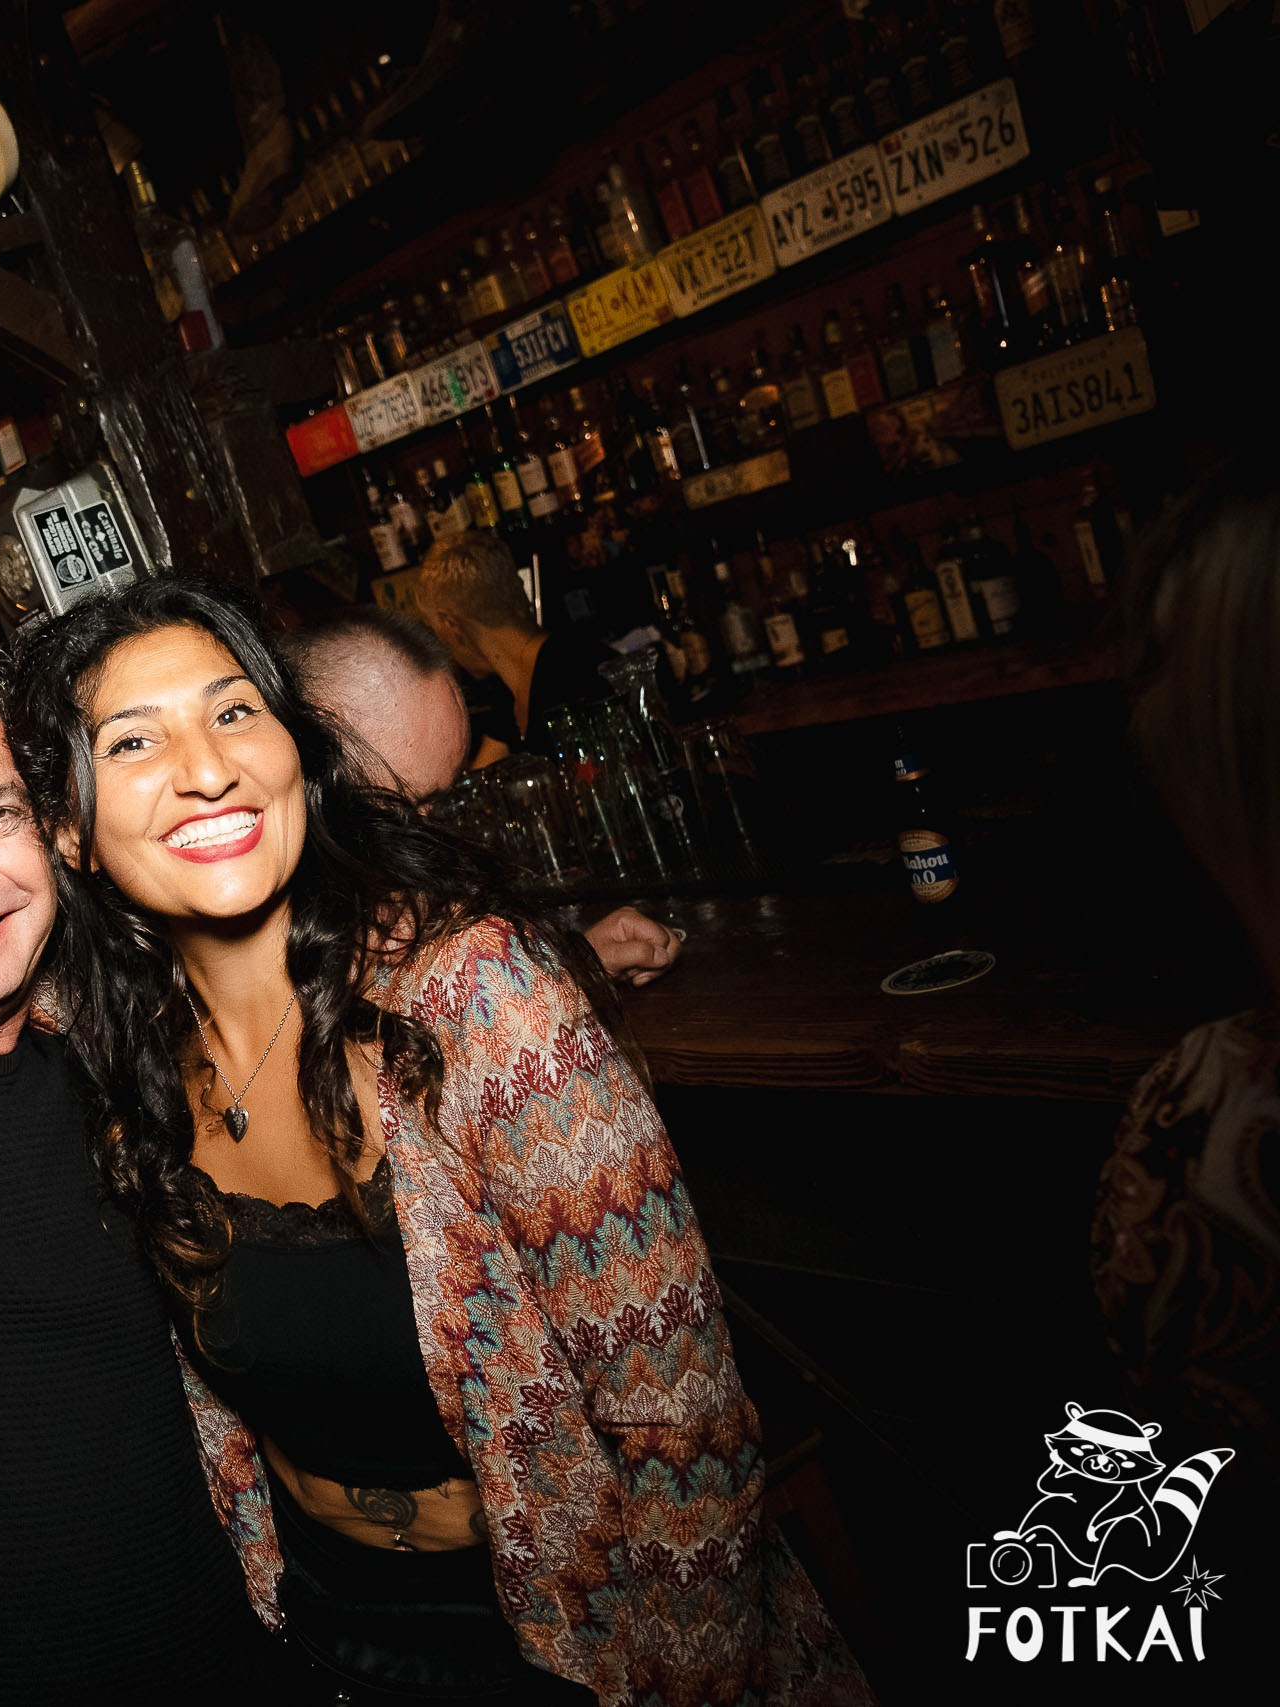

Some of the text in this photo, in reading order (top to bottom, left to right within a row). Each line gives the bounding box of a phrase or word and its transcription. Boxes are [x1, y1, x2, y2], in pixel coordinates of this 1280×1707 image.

[958, 107, 1016, 164] 526
[1011, 361, 1143, 434] 3AIS841
[81, 520, 92, 538] Car
[97, 510, 123, 559] Cardinals
